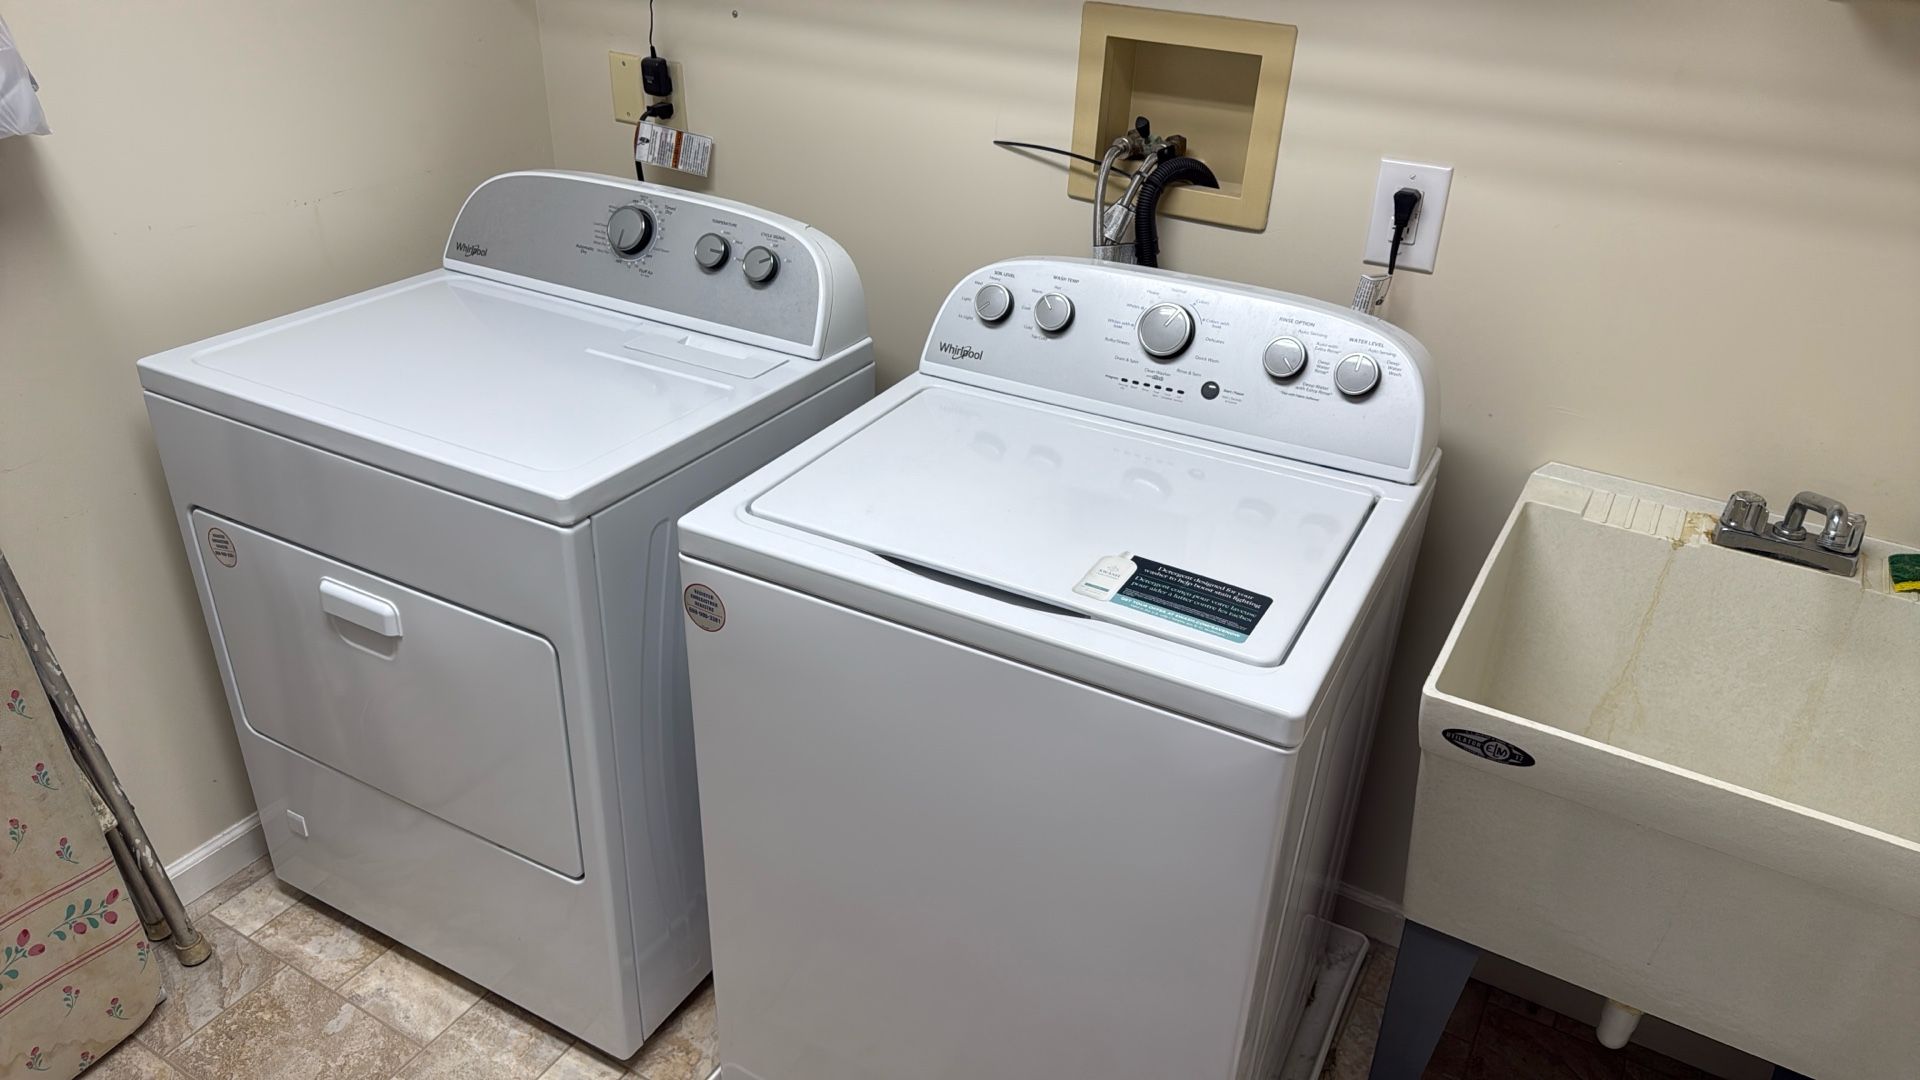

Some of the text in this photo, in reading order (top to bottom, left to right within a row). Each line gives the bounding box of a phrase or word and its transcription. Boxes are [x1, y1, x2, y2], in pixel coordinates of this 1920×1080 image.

[456, 242, 488, 258] Whirlpool
[1068, 276, 1080, 284] TEMP
[1294, 320, 1316, 328] OPTION
[939, 341, 984, 361] Whirlpool
[1368, 340, 1384, 348] LEVEL
[1144, 568, 1168, 578] washer
[1177, 578, 1193, 586] help
[1194, 582, 1214, 593] boost
[1214, 590, 1232, 598] stain
[1158, 566, 1193, 580] Detergent
[1194, 578, 1226, 591] designed
[1238, 592, 1254, 600] your
[1173, 594, 1192, 602] lutter
[1194, 602, 1216, 610] contre
[1228, 612, 1252, 622] taches
[1192, 594, 1210, 602] pour
[1212, 600, 1229, 608] votre
[1230, 605, 1256, 618] laveuse
